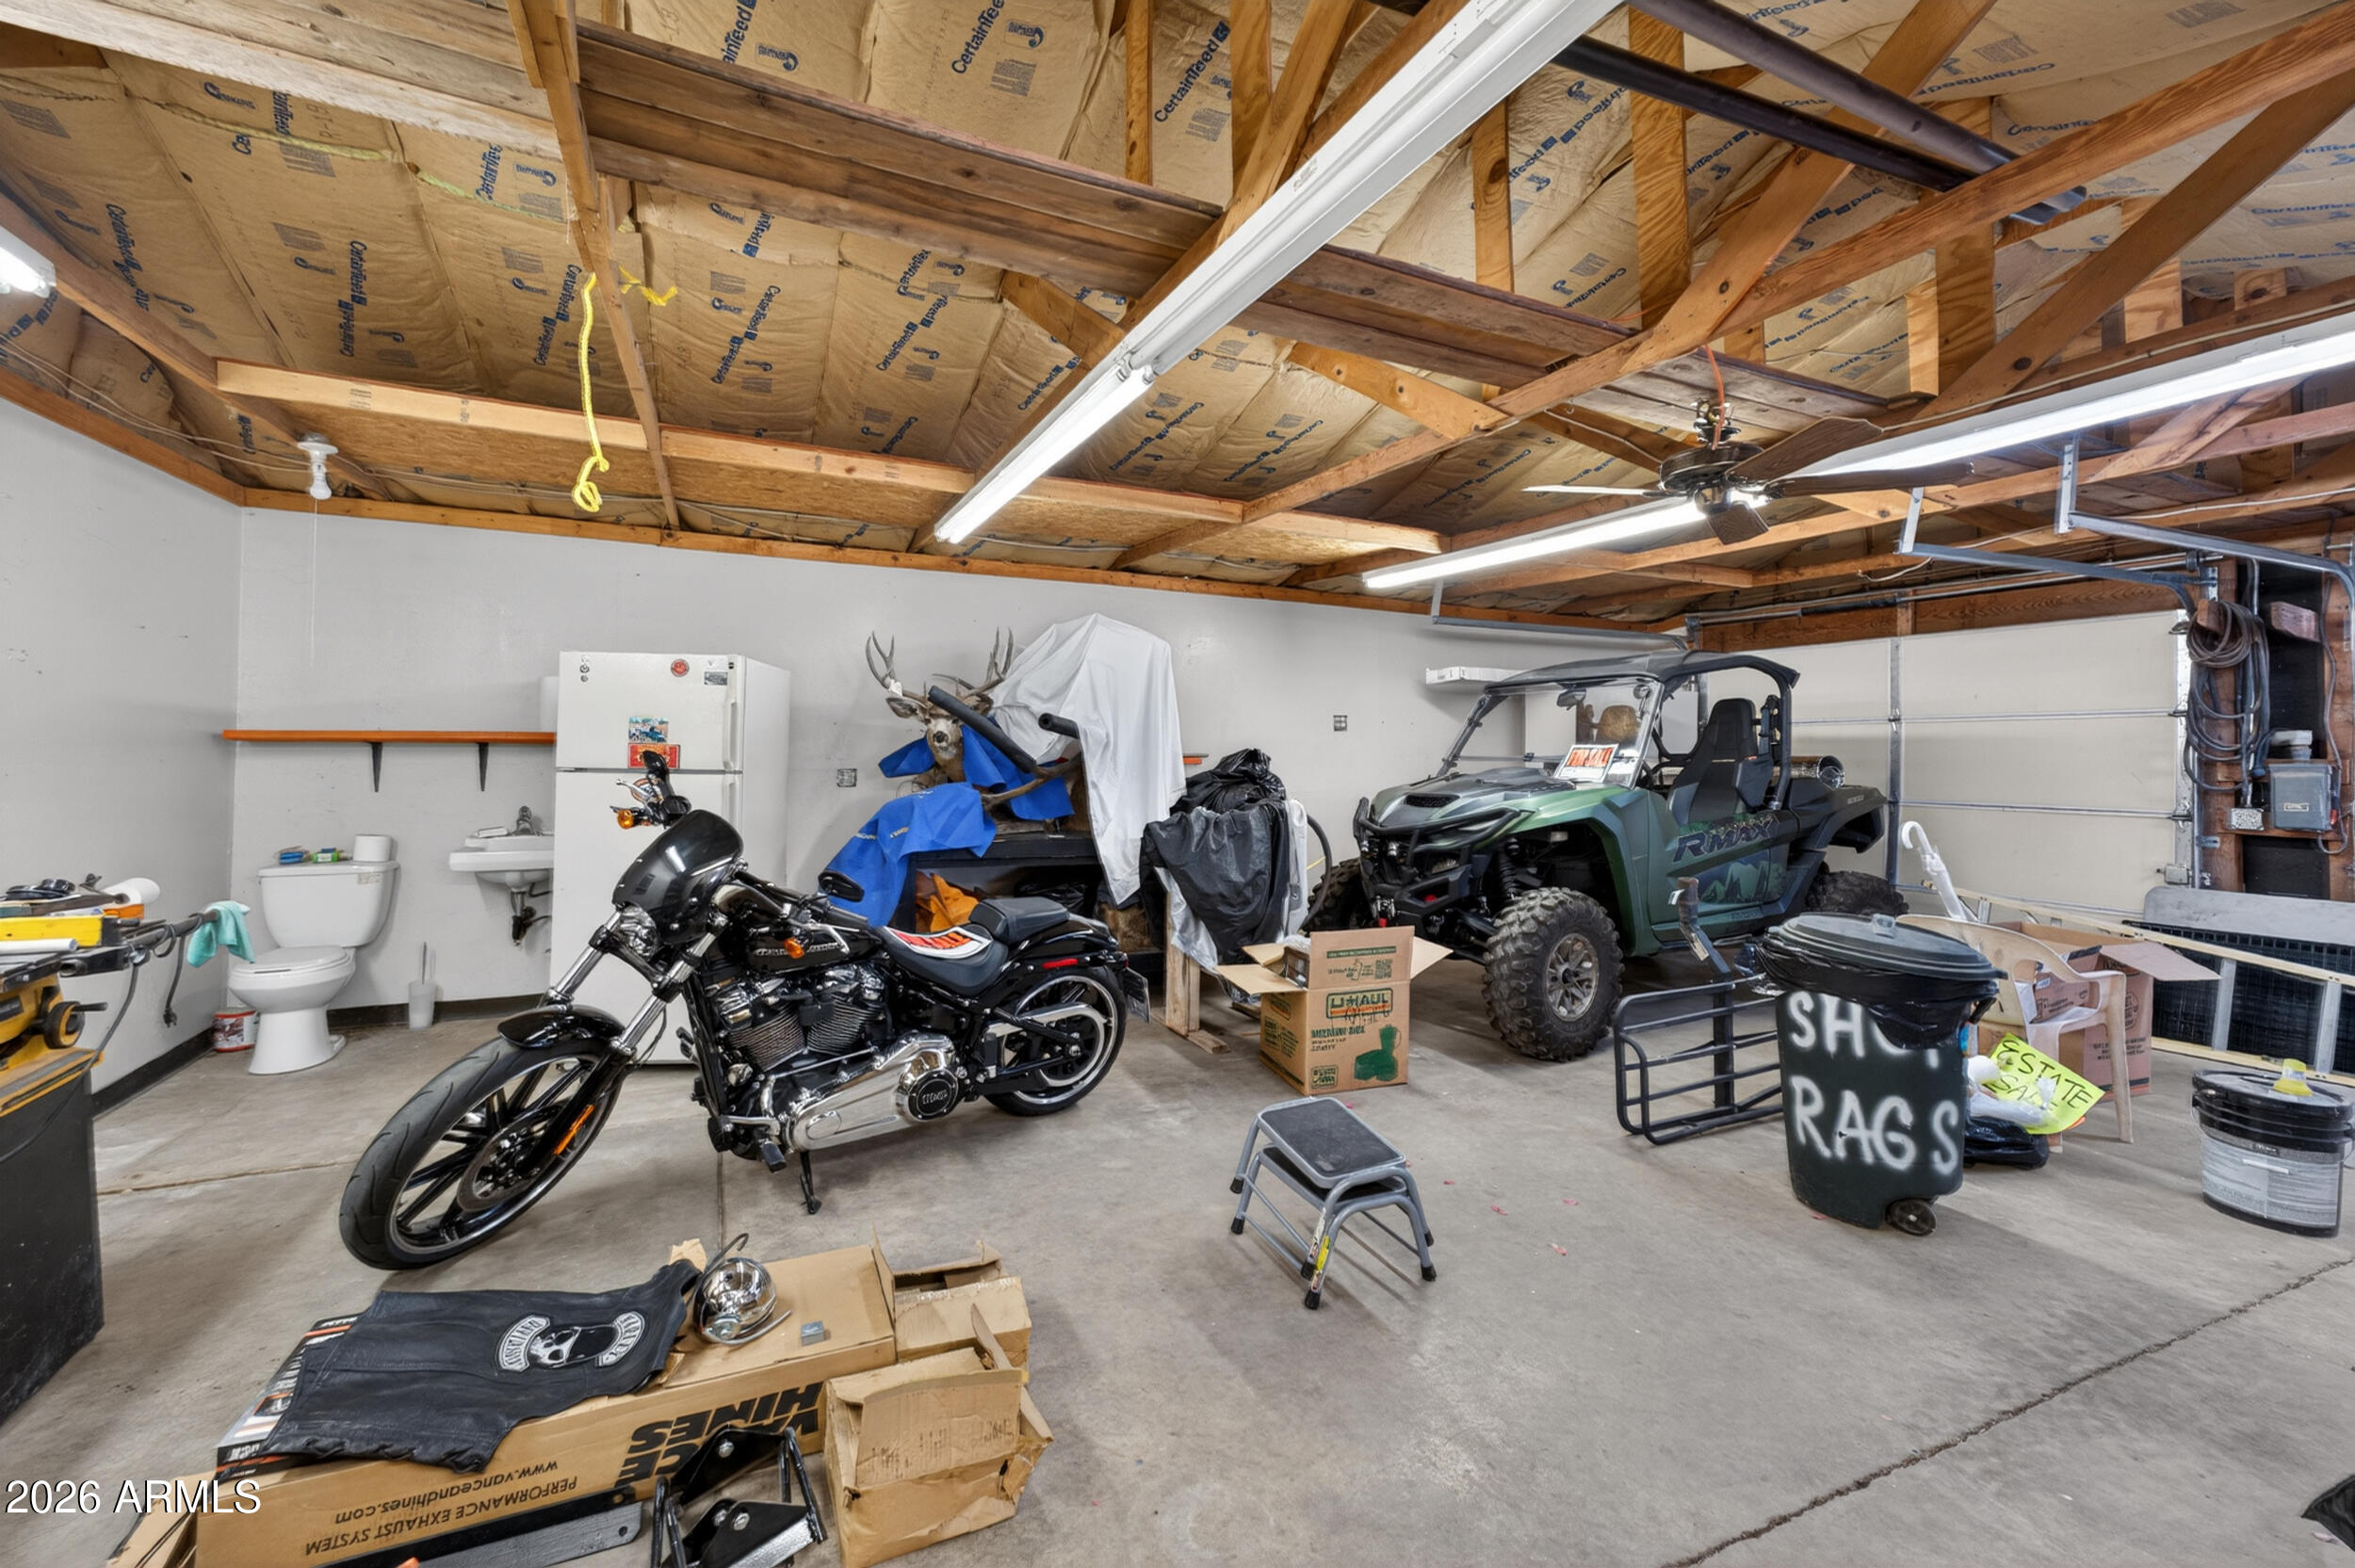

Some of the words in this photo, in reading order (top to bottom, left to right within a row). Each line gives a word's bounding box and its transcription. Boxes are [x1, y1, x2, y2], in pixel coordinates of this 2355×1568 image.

[1154, 40, 1220, 122] CertainTeed
[1789, 990, 1941, 1071] SH
[614, 1409, 819, 1489] VCE
[627, 1382, 825, 1454] HINES
[334, 1461, 559, 1525] www.vanceandhines.com
[374, 1509, 457, 1540] EXHAUST
[456, 1476, 577, 1520] PERFORMANCE
[305, 1528, 371, 1557] SYSTEM
